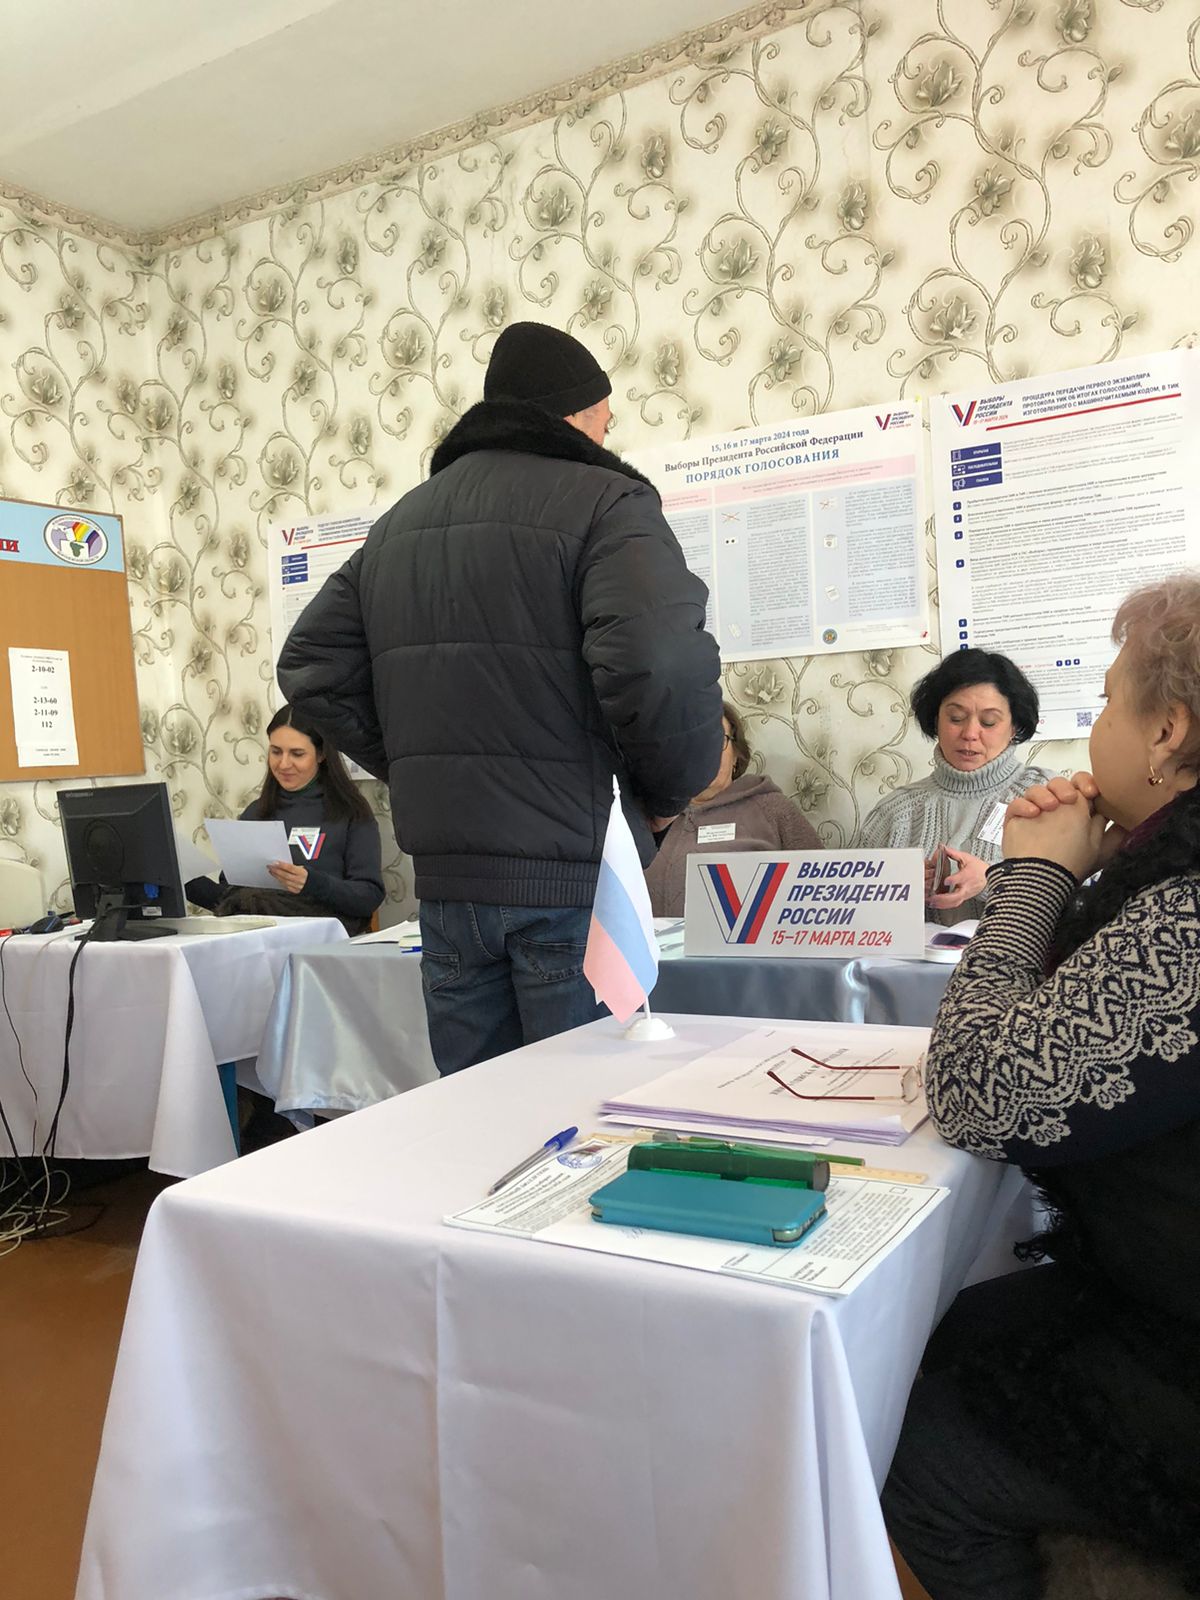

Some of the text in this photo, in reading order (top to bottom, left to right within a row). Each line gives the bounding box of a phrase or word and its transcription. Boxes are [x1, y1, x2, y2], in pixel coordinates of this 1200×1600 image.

[980, 395, 1005, 405] ВЫБОРЫ
[1022, 391, 1055, 402] ПРОЦЕДУРА
[1055, 385, 1085, 396] ПЕРЕДАЧИ
[1086, 380, 1111, 390] ПЕРВОГО
[1022, 399, 1055, 409] ПРОТОКОЛА
[1077, 389, 1098, 399] ИТОГАХ
[1022, 403, 1072, 416] ИЗГОТОВЛЕННОГО
[1167, 382, 1179, 390] ТИК
[974, 410, 998, 419] РОССИИ
[977, 400, 1013, 412] ПРЕЗИДЕНТА
[711, 444, 721, 453] 15,
[724, 442, 732, 450] 16
[740, 439, 748, 448] 17
[749, 435, 772, 446] марта
[773, 430, 791, 440] 2024
[792, 428, 810, 439] года
[664, 431, 864, 472] Выборы Президента Российской Федерации
[686, 466, 741, 484] ПОРЯДОК
[745, 448, 840, 474] ГОЛОСОВАНИЯ
[31, 665, 55, 674] 2-10-02
[33, 696, 58, 704] 2-13-60
[34, 708, 58, 716] 2-11-09
[797, 860, 884, 879] ВЫБОРЫ
[787, 884, 911, 904] ПРЕЗИДЕНТА
[777, 907, 856, 925] РОССИИ
[809, 930, 857, 946] МАРТА
[857, 930, 893, 946] 2024
